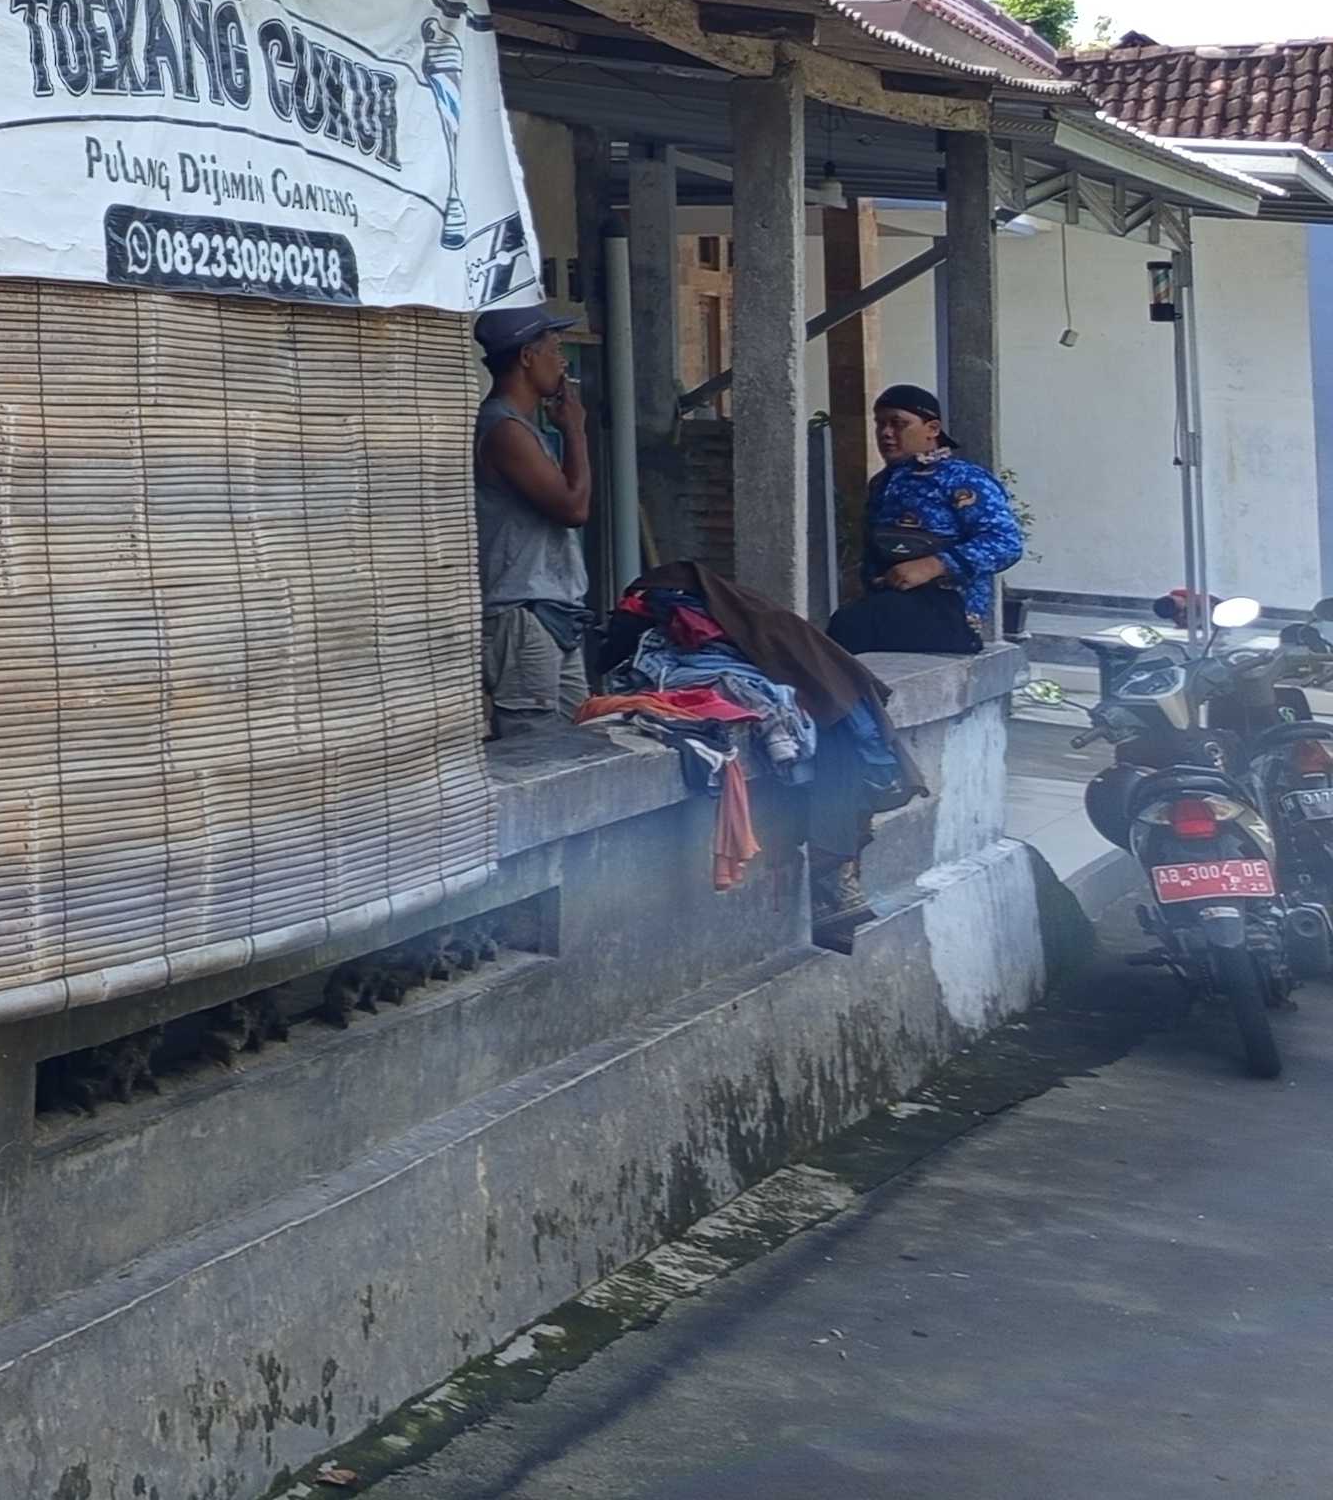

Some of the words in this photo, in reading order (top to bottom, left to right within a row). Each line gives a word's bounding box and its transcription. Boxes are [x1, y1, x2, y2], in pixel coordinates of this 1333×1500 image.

[257, 18, 402, 172] CUKUR
[155, 228, 342, 290] 082330890218
[1242, 861, 1266, 877] DE
